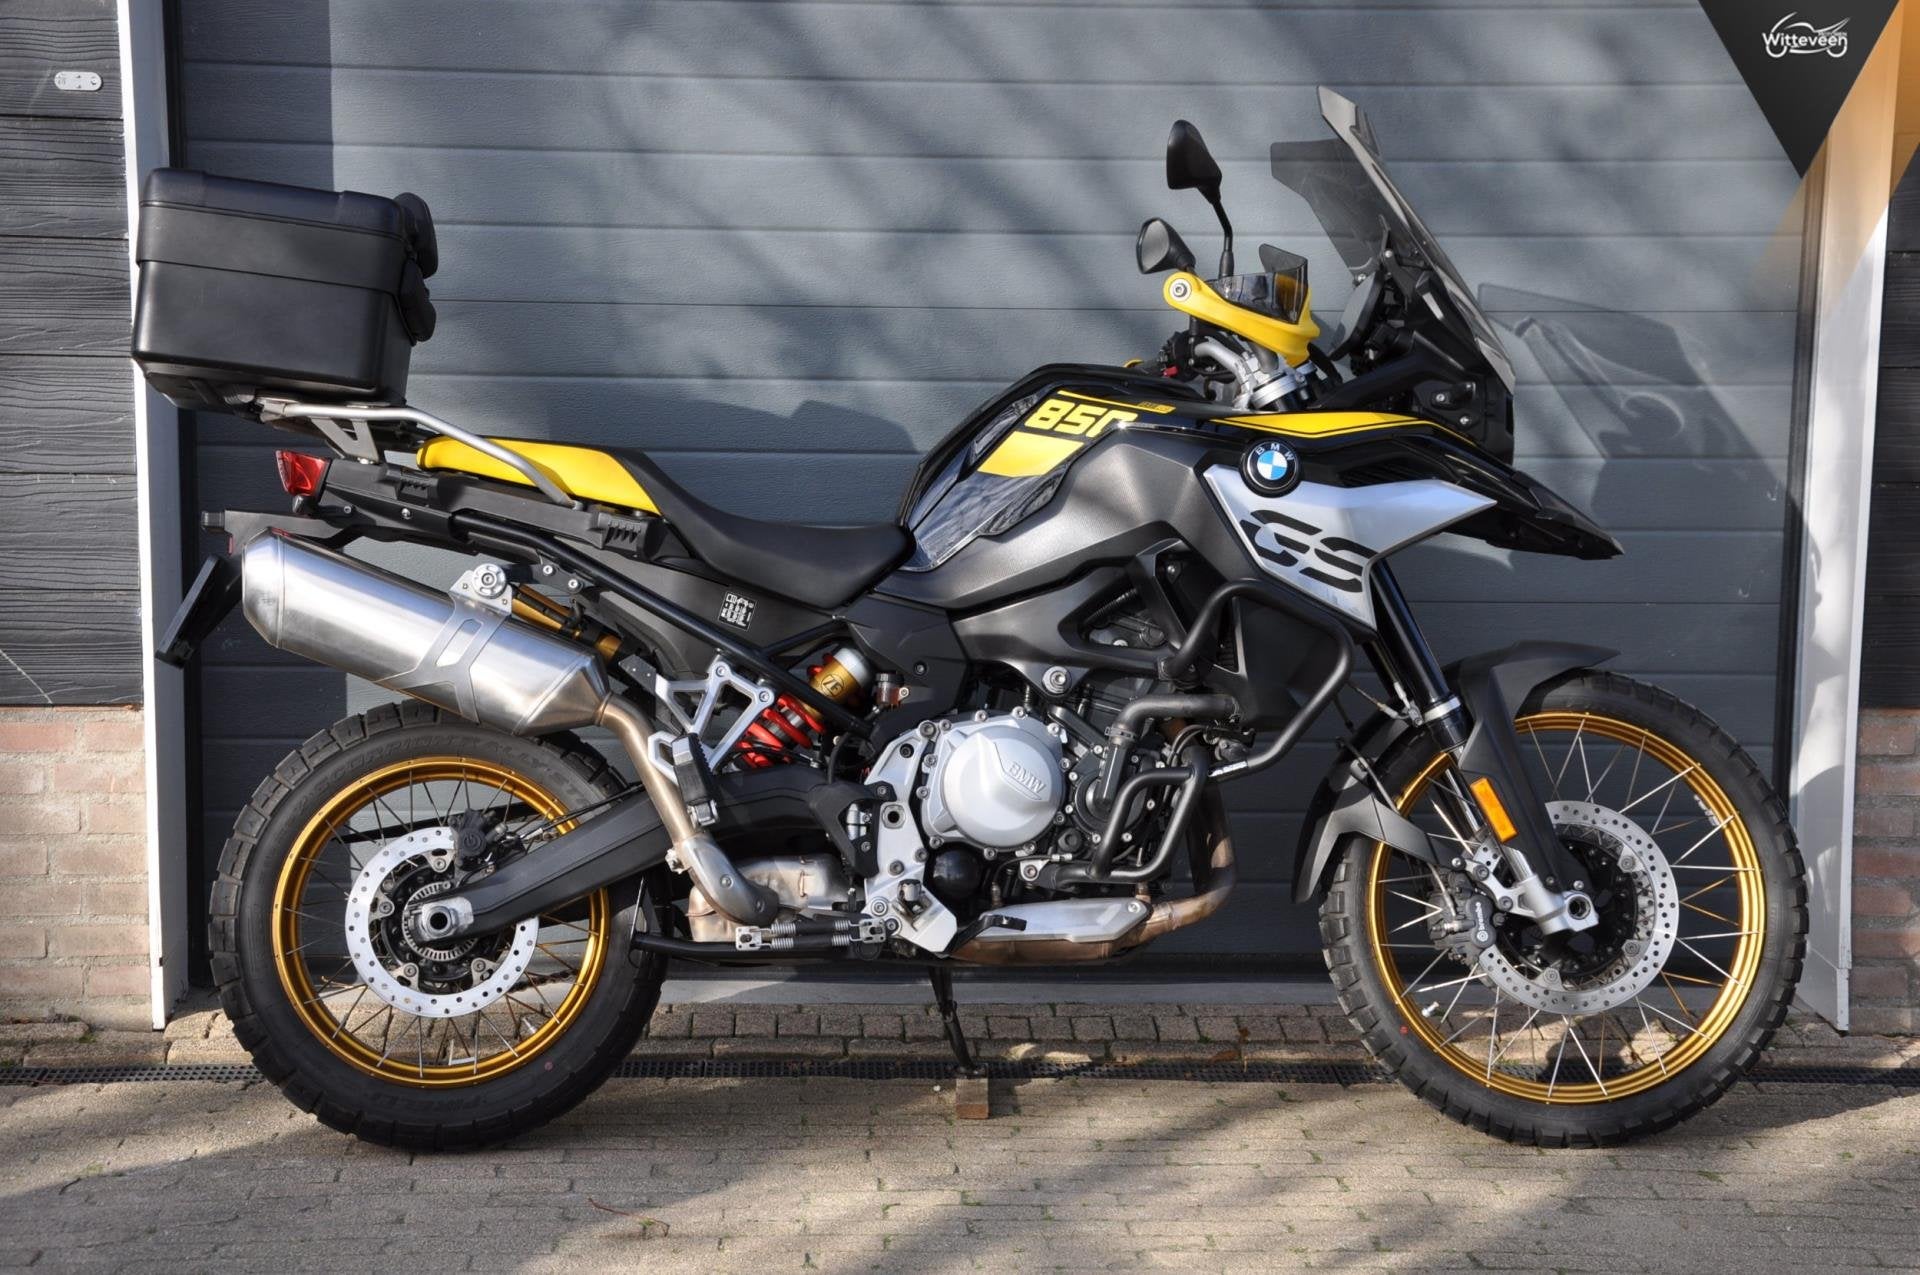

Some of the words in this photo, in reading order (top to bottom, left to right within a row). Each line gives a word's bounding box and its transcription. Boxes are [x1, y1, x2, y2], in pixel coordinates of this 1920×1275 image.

[1254, 442, 1295, 461] BMW
[1240, 509, 1377, 593] GS
[1009, 761, 1047, 794] BMW
